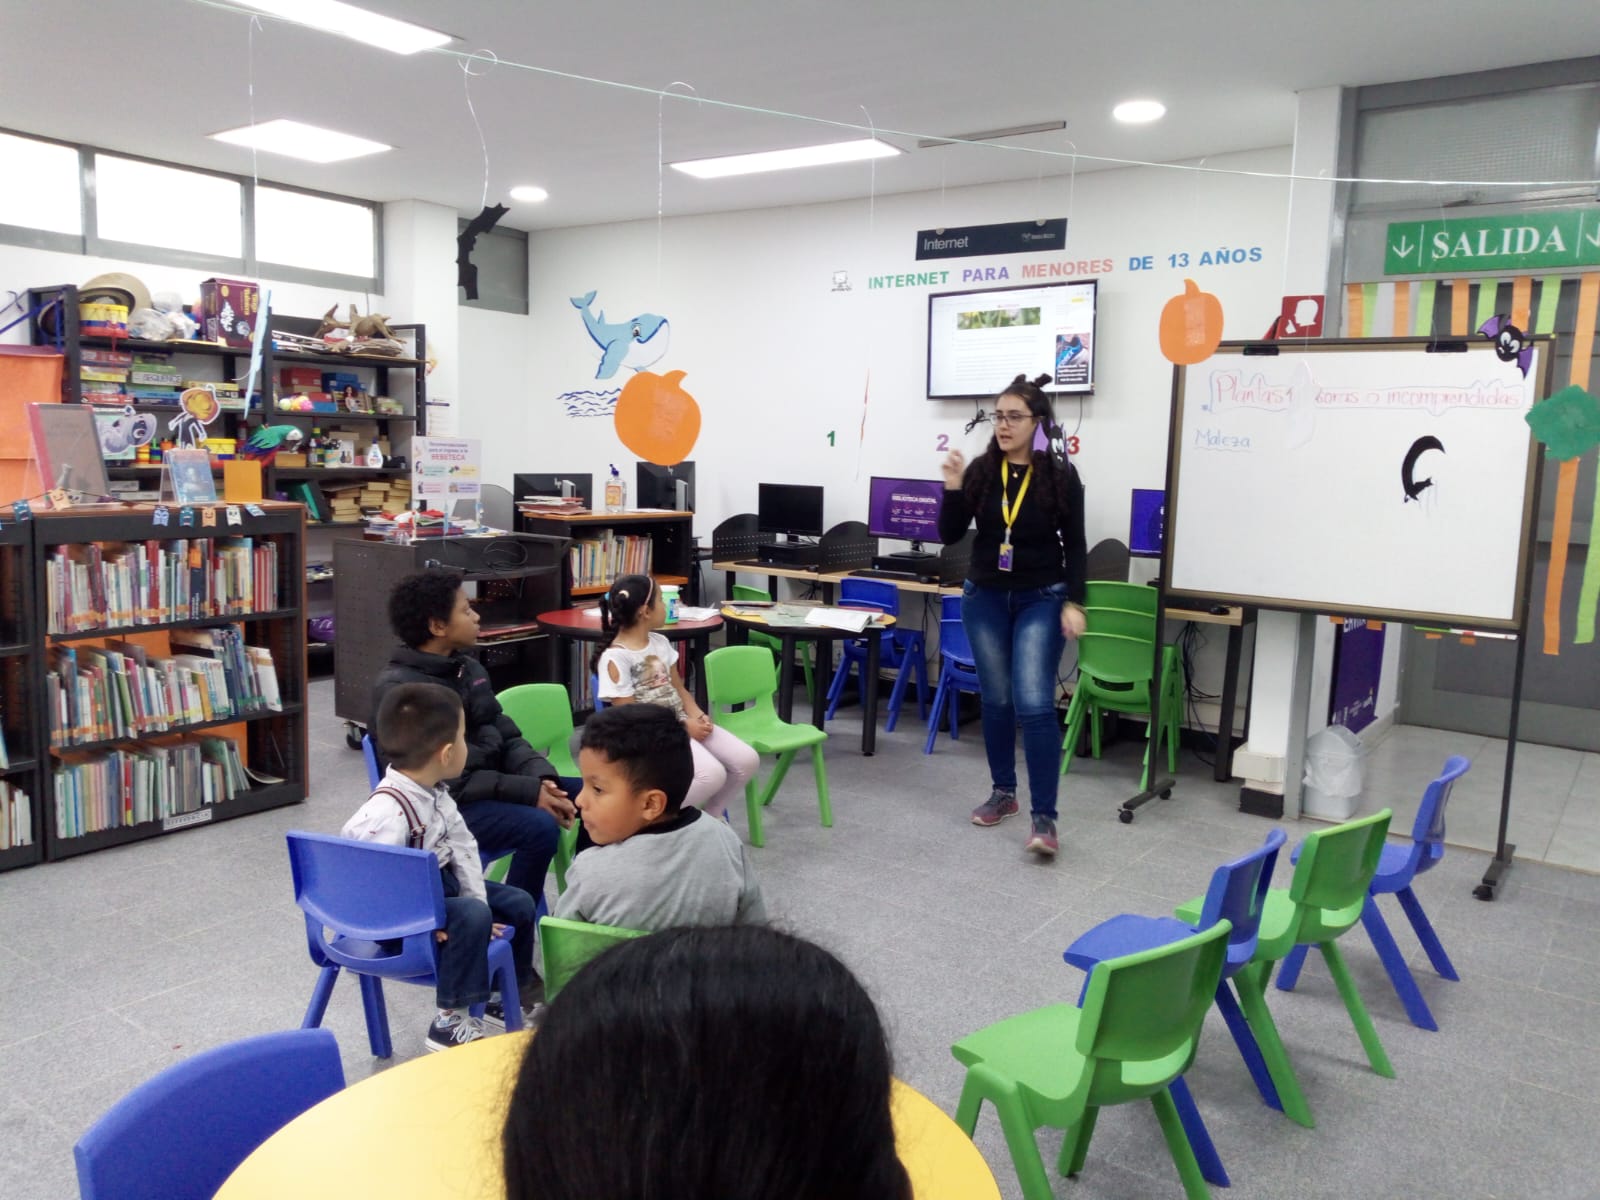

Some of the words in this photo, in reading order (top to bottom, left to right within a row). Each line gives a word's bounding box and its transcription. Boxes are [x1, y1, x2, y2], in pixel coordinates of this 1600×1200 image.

[923, 236, 969, 251] Internet
[1432, 225, 1567, 259] SALIDA
[868, 271, 950, 290] INTERNET
[962, 266, 1010, 282] PARA
[1021, 258, 1114, 279] MENORES
[1128, 255, 1154, 271] DE
[1167, 252, 1190, 269] 13
[1199, 247, 1263, 267] AÑOS
[1216, 373, 1284, 404] Plantas
[826, 430, 836, 447] 1
[936, 434, 949, 451] 2
[1067, 436, 1080, 455] 3
[1194, 428, 1251, 449] Maleza
